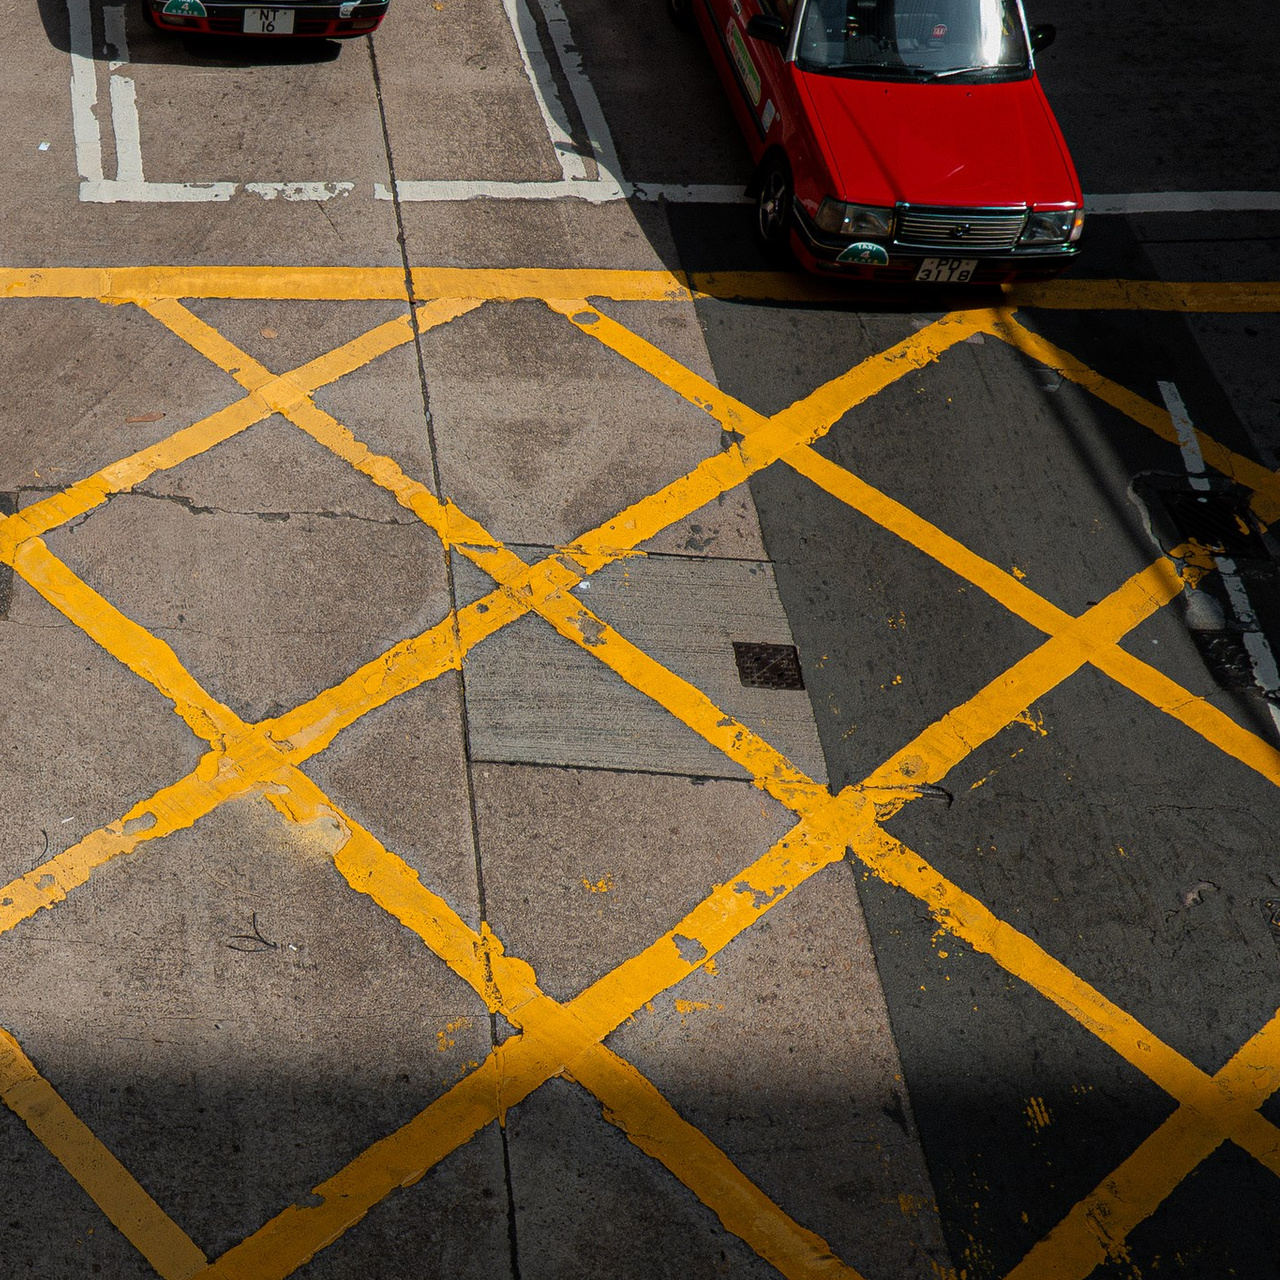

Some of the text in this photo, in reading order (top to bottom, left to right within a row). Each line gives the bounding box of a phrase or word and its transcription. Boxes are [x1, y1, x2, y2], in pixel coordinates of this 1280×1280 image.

[259, 10, 279, 21] NT
[261, 21, 275, 32] 16
[918, 269, 970, 281] 3118
